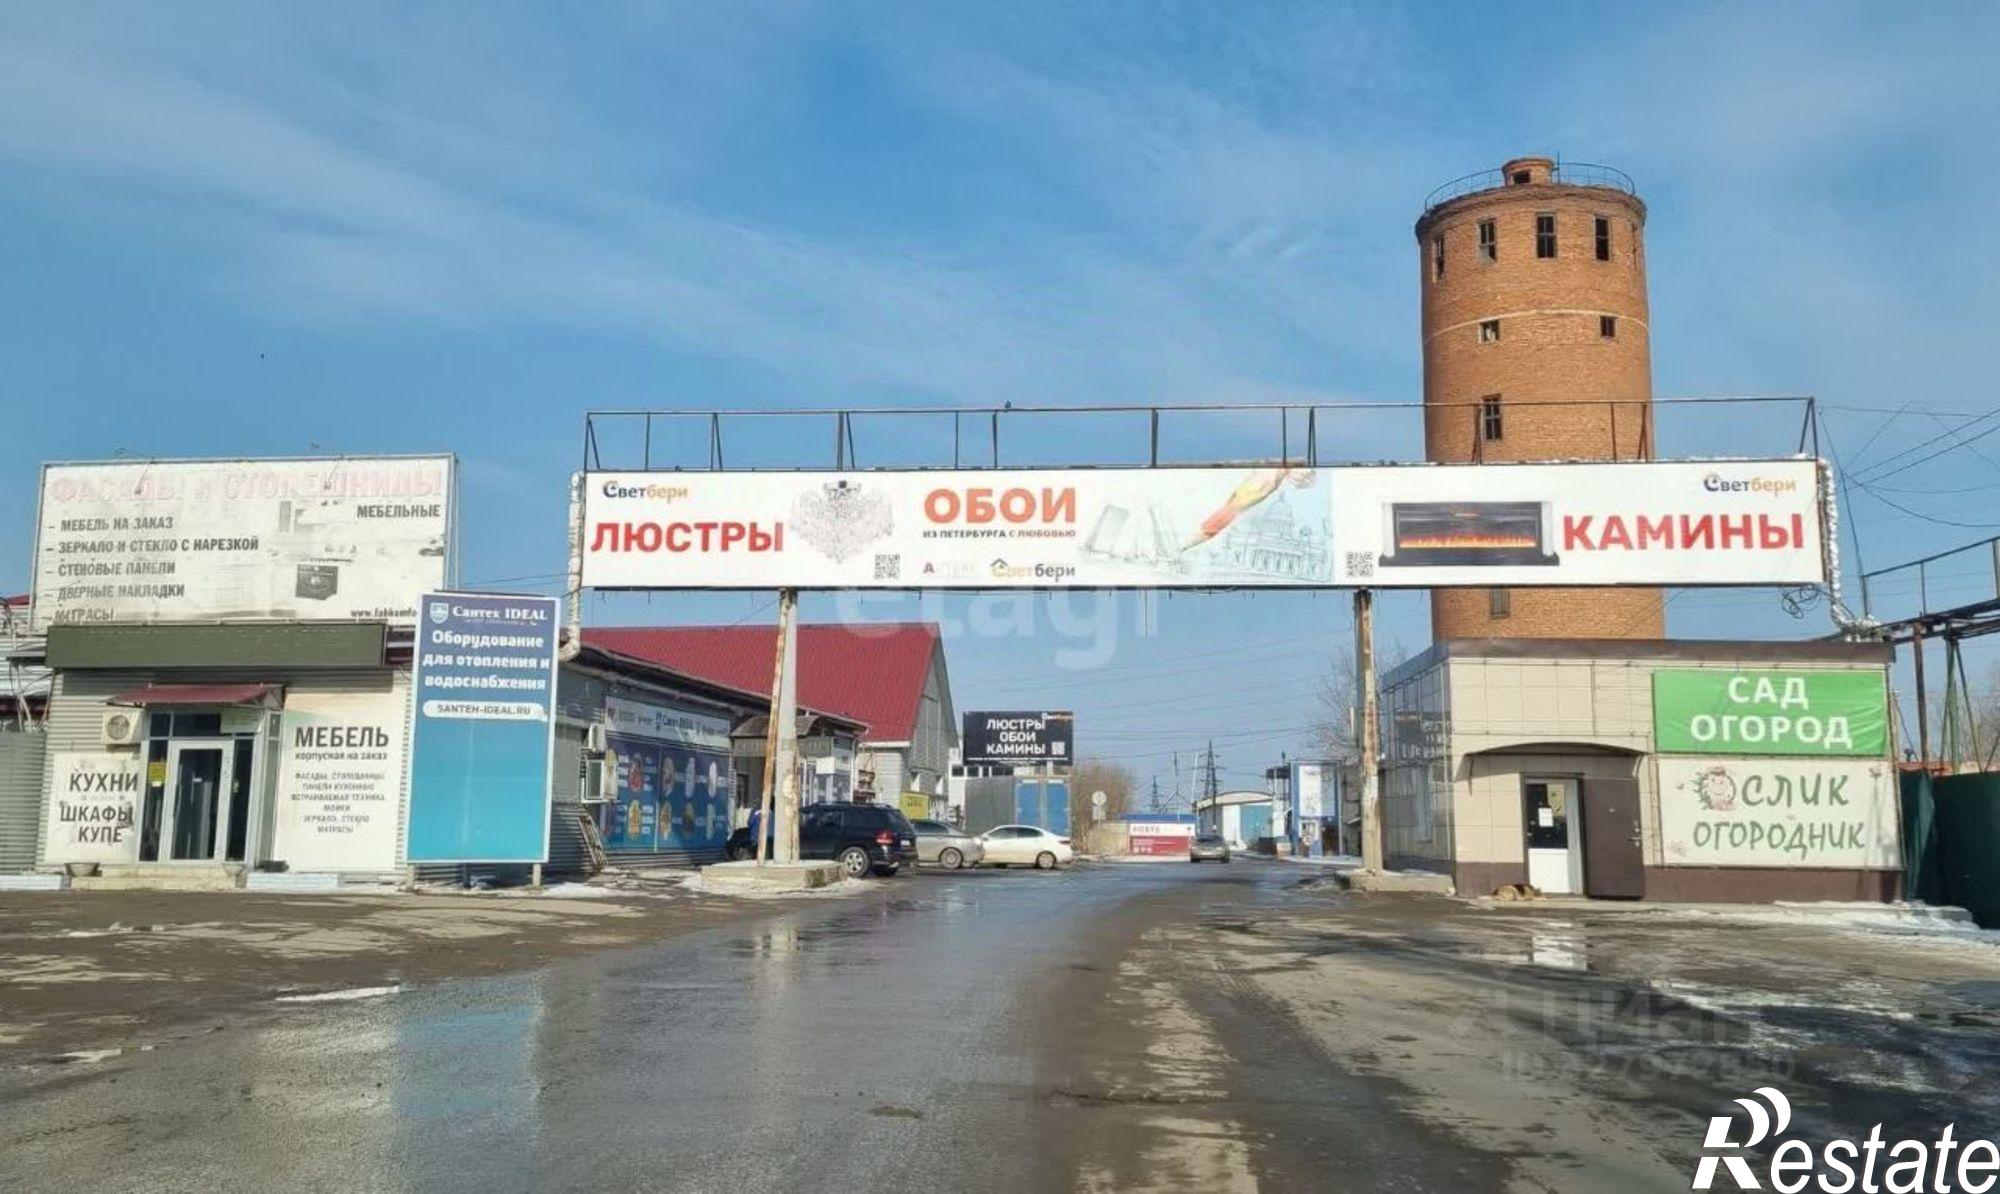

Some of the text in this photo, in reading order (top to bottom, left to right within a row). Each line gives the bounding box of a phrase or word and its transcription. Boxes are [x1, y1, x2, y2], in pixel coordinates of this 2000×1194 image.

[603, 480, 687, 504] Светбери
[1704, 473, 1797, 497] Светбери
[357, 504, 441, 519] МЕБЕЛЬНЫЕ
[924, 487, 1076, 524] ОБОИ
[60, 517, 174, 532] МЕБЕЛЬ НА ЗАКАЗ
[1563, 514, 1804, 551] КАМИНЫ
[591, 522, 783, 553] ЛЮСТРЫ
[923, 530, 1076, 538] ИЗ ПЕТЕРБУРГА С ЛЮБОВЬЮ
[58, 537, 259, 554] ЗЕРКАЛО И СТЕКЛО С НАРЕЗКОЙ
[58, 562, 175, 577] СТЕНОВЫЕ ПАНЕЛИ
[991, 558, 1076, 582] Светбери
[57, 584, 185, 602] ДВЕРНЫЕ НАКЛАДКИ
[54, 609, 114, 625] МАТРАСЫ
[452, 606, 548, 620] Сантех IDEAL
[432, 630, 544, 649] Оборудование
[423, 653, 550, 669] для отопления и
[425, 675, 546, 690] водоснабжения
[1729, 677, 1809, 709] САД
[438, 704, 531, 715] SANTEH-IDEAL.RU
[986, 719, 1045, 730] ЛЮСТРЫ
[1691, 714, 1852, 749] ОГОРОД
[295, 726, 389, 748] МЕБЕЛЬ
[999, 732, 1036, 742] ОБОИ
[295, 752, 387, 761] корпусная на заказ
[986, 744, 1045, 755] КАМИНЫ
[69, 773, 138, 792] КУХНИ
[60, 805, 133, 824] ШКАФЫ
[78, 826, 123, 842] КУПЕ
[1693, 821, 1865, 860] ОГОРОДНИК
